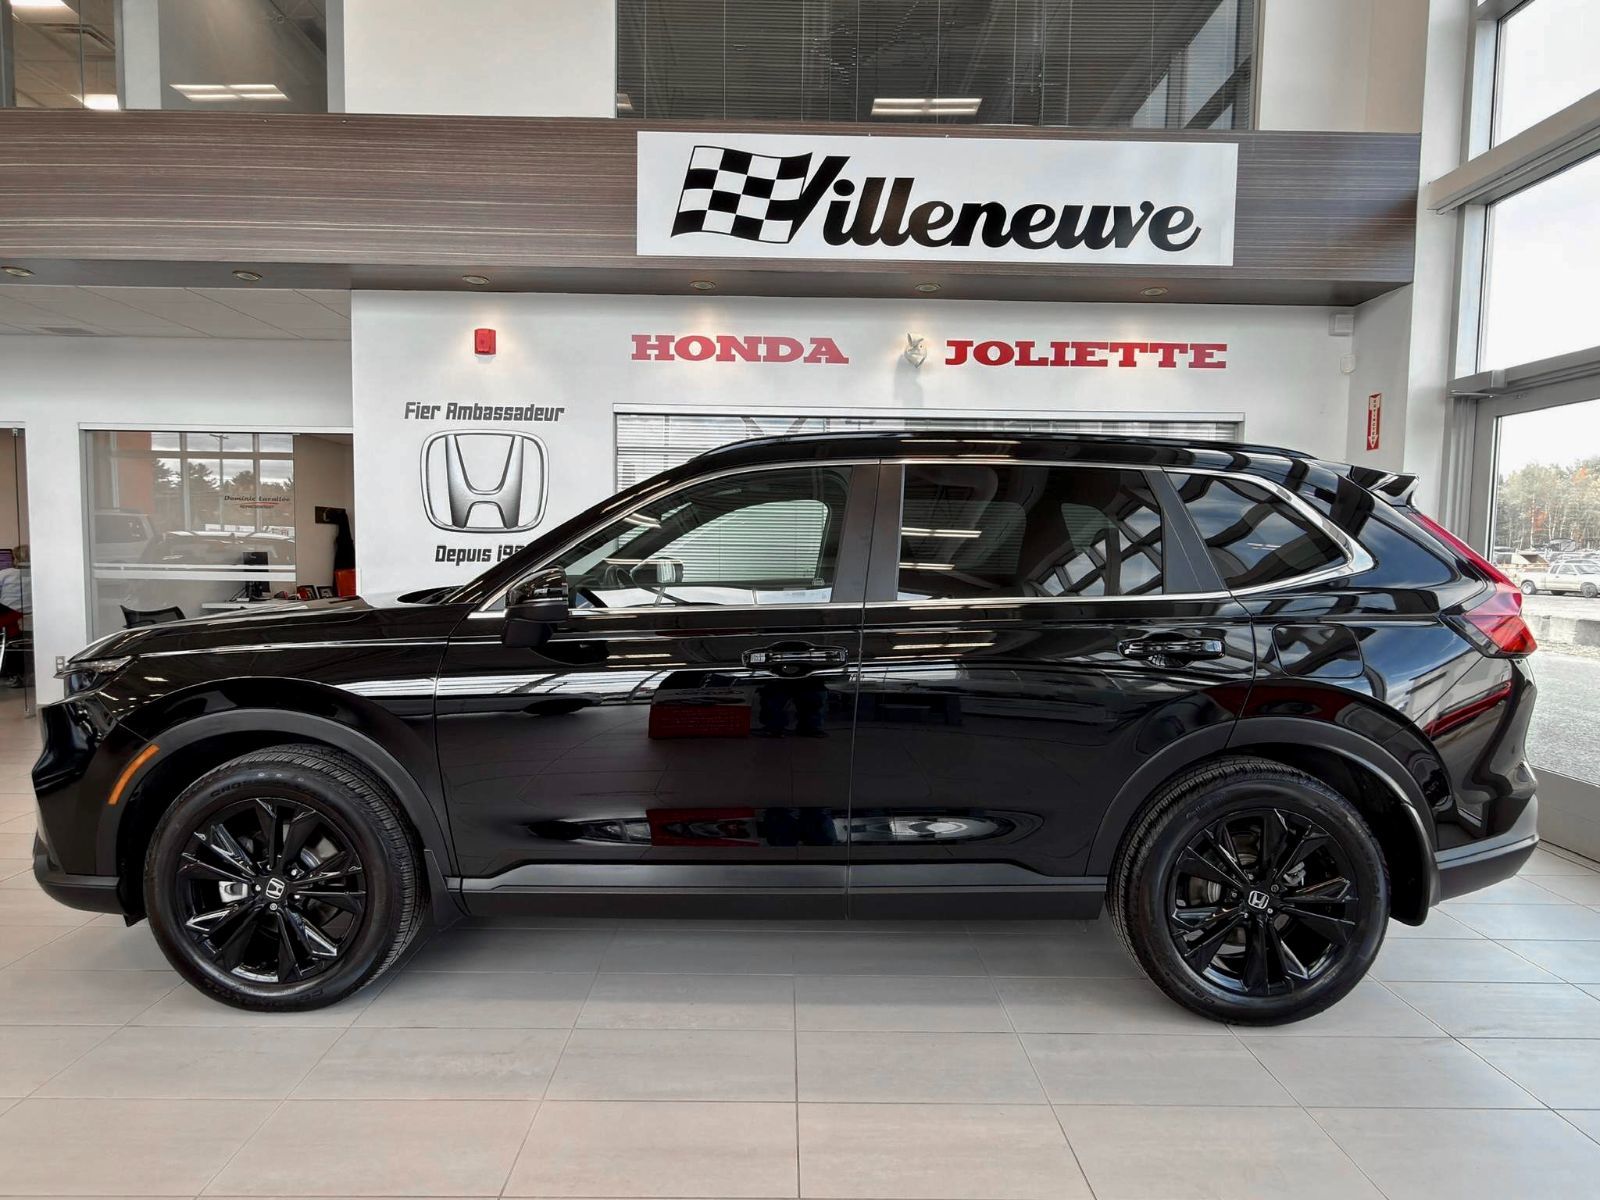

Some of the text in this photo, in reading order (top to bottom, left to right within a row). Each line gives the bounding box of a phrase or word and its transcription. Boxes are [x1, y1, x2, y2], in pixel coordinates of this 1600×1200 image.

[776, 153, 1202, 252] Villeneuve
[632, 334, 1227, 369] HONDA JOLIETTE
[404, 401, 565, 422] Fier Ambassadeur
[435, 545, 492, 567] Depuis
